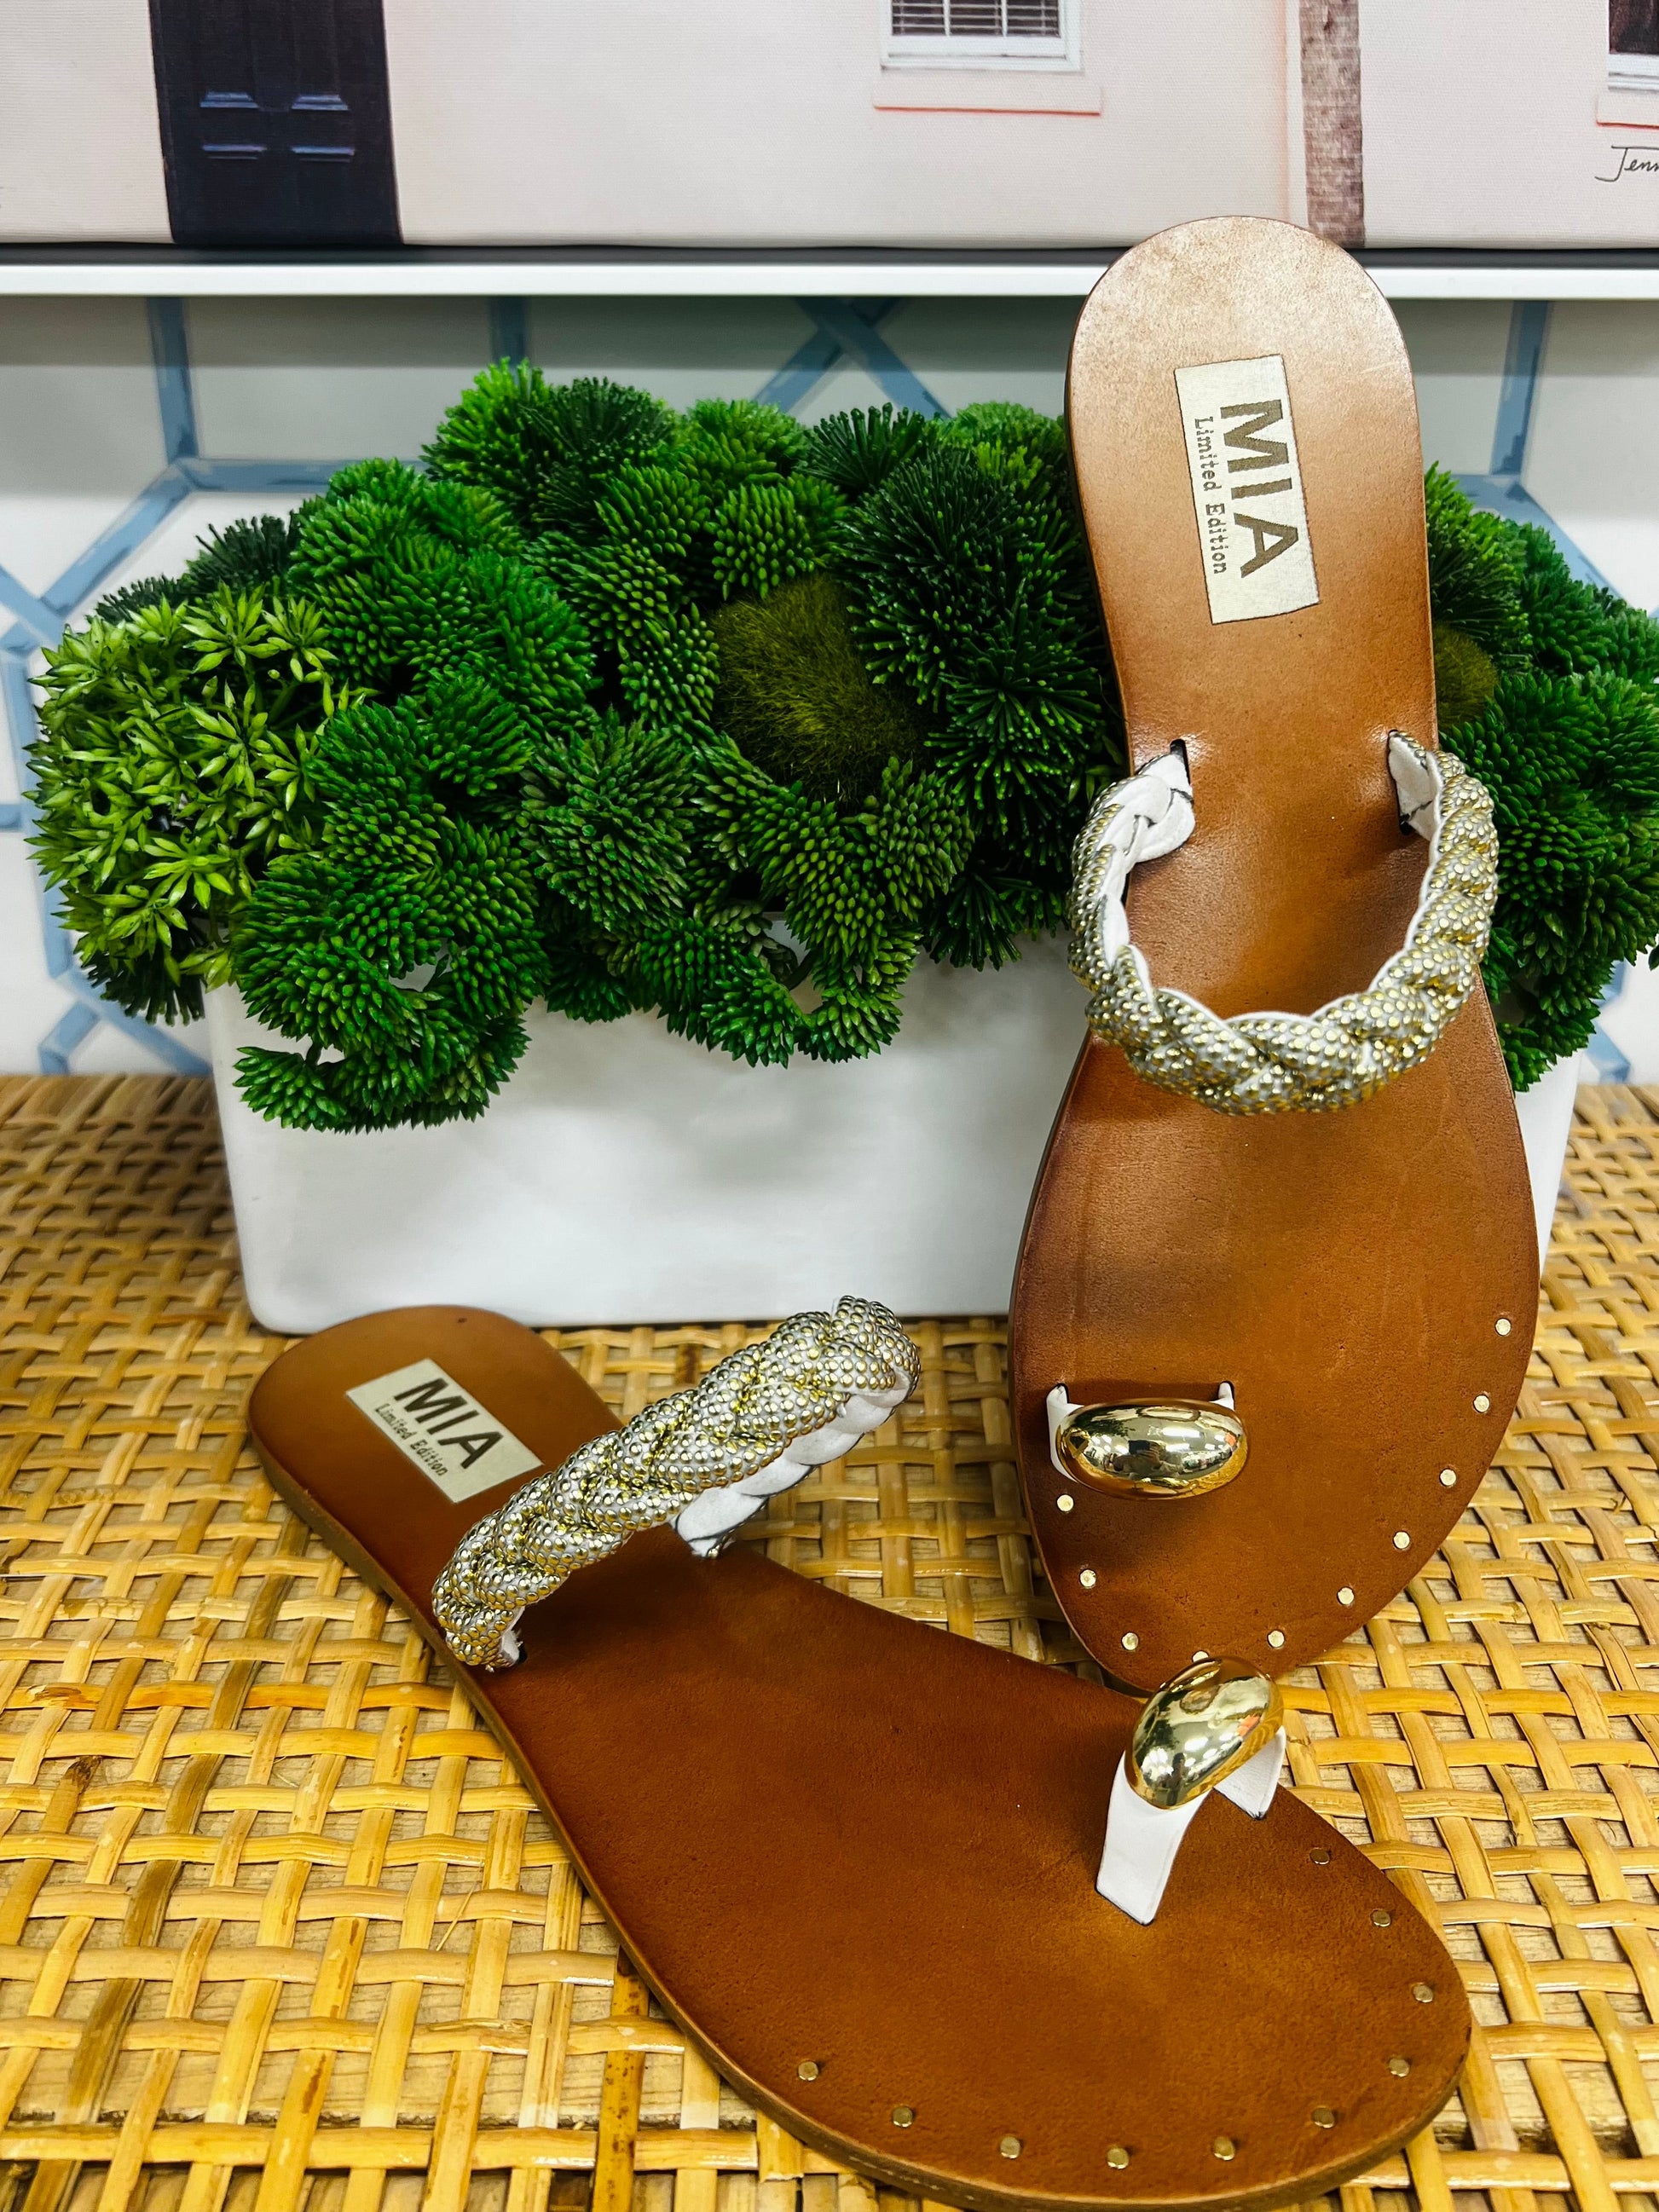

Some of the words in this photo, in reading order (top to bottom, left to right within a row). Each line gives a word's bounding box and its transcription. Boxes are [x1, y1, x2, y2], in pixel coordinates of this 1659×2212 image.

[1194, 416, 1222, 492] Limited
[1220, 399, 1298, 579] MIA
[1205, 503, 1228, 575] Edition
[375, 1404, 417, 1441] Limited
[410, 1439, 448, 1476] Edition
[393, 1377, 504, 1470] MIA
